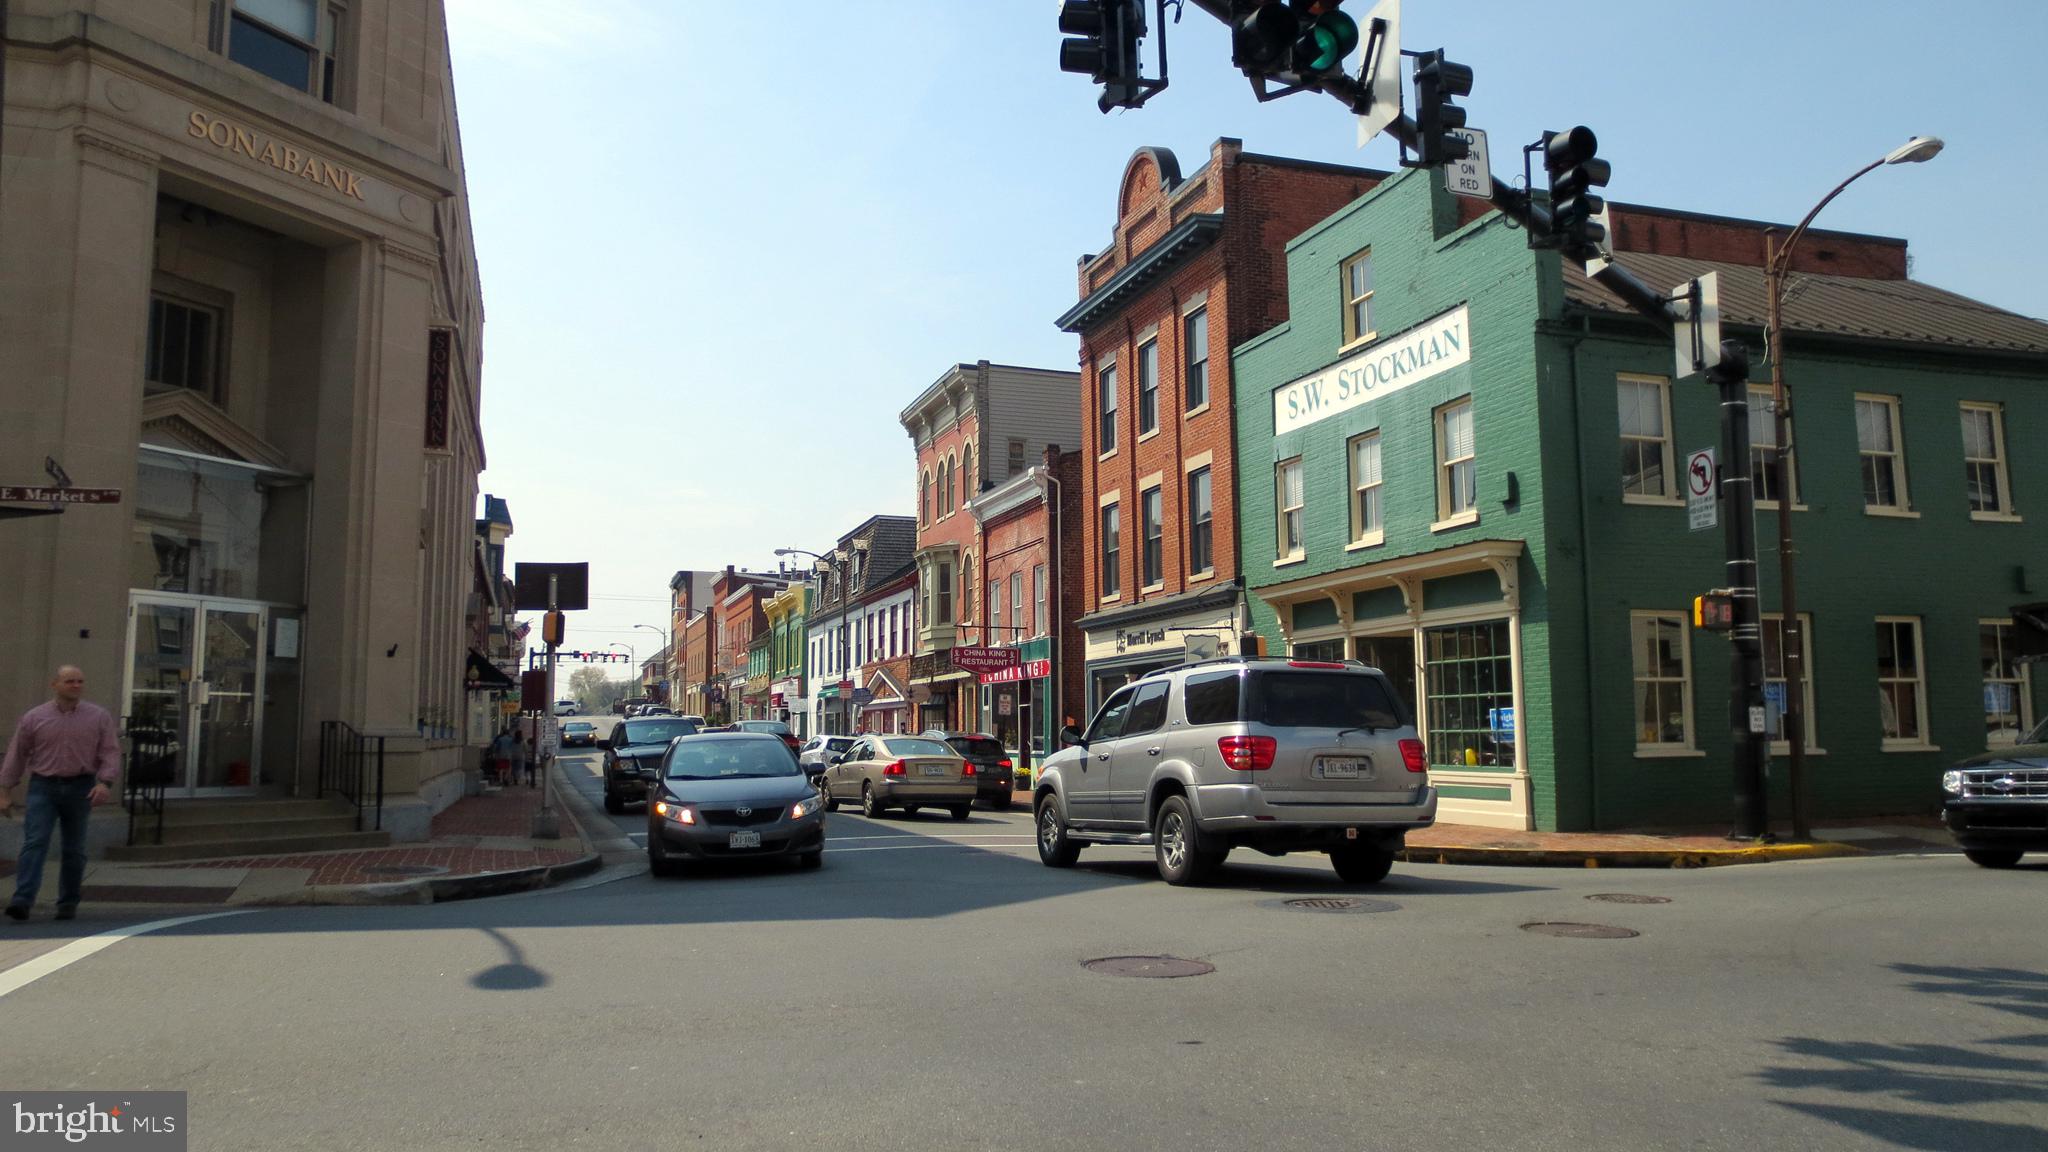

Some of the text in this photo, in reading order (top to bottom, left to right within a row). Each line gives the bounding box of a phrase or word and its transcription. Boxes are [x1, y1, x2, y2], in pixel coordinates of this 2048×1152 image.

[188, 110, 366, 201] SONABANK
[1461, 163, 1475, 175] ON
[1460, 178, 1479, 191] RED
[1288, 324, 1461, 420] S.W. STOCKMAN
[432, 335, 447, 444] SONABANK
[24, 488, 85, 502] Market
[963, 649, 986, 657] CHINA
[961, 658, 1008, 666] RESTAURANT
